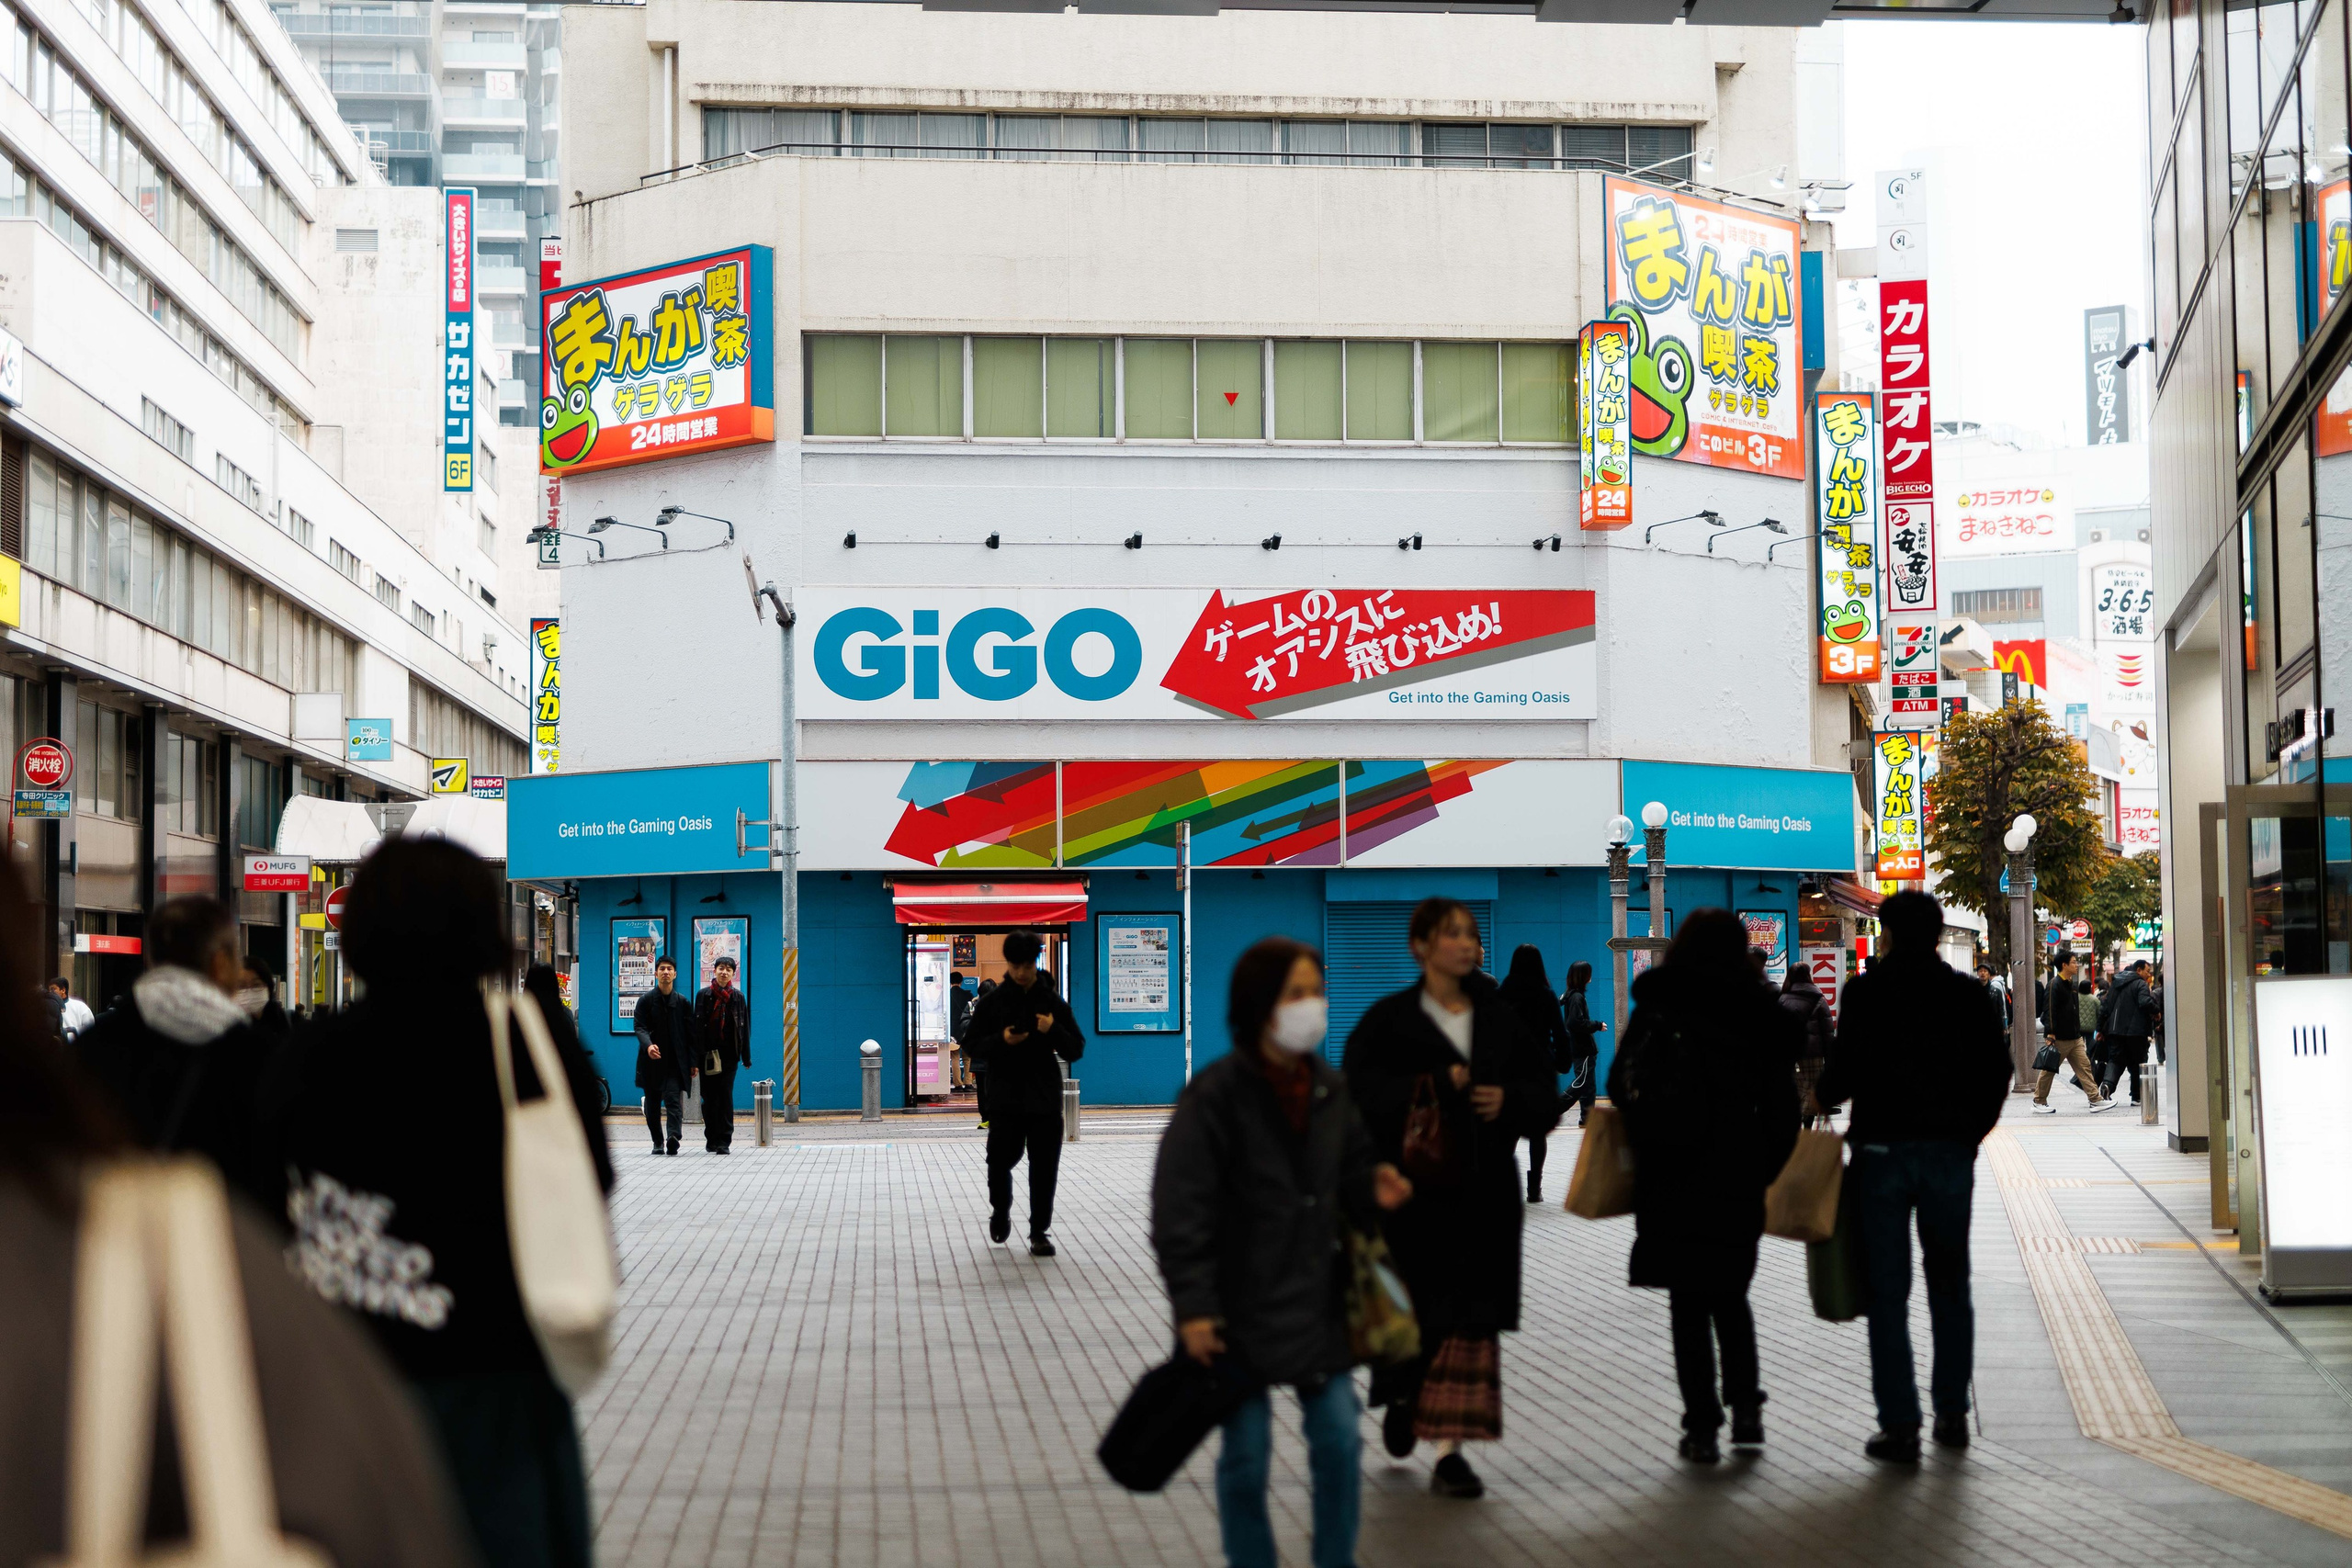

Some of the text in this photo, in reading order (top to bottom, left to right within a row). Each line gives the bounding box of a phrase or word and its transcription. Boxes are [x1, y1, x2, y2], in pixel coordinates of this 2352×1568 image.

[1910, 171, 1922, 180] 5F
[452, 203, 467, 302] 大きいサイズの店
[1619, 199, 1792, 328] まんが
[2091, 342, 2117, 354] LAB
[447, 321, 470, 445] サカゼン
[1883, 299, 1930, 474] カラオケ
[613, 371, 714, 421] ゲラゲラ
[1709, 389, 1770, 419] ゲラゲラ
[1701, 412, 1722, 423] COMIC
[1728, 417, 1759, 429] INTERNET
[630, 416, 718, 451] 24時間営業
[449, 460, 469, 479] 6F
[1886, 483, 1932, 495] BIG ECHO
[1972, 489, 2040, 506] カラオケ
[1597, 490, 1626, 507] 24
[1892, 510, 1910, 524] 2F
[1959, 514, 2053, 542] まねきねこ
[1204, 589, 1337, 663] ゲームの
[2112, 615, 2143, 636] 酒場
[1244, 589, 1407, 694] オアシスに
[813, 606, 1143, 702] GiGO
[1829, 645, 1873, 675] 3F
[1898, 673, 1930, 685] たばこ
[1388, 691, 1570, 706] Get into the Gaming Oasis
[1907, 686, 1921, 698] 酒
[1902, 700, 1929, 711] ATM
[362, 737, 388, 745] ダイソー
[28, 757, 62, 773] 消火栓
[472, 778, 503, 787] 大きいサイズ
[22, 792, 65, 800] 寺田クリニック
[472, 789, 503, 798] サカゼン
[1670, 810, 1812, 833] Get into the Gaming Oasis
[2120, 807, 2153, 819] ラオケ
[559, 814, 713, 839] Get into the Gaming Oasis
[269, 862, 297, 870] MUFG
[1895, 856, 1920, 870] 入口
[253, 878, 300, 886] 三菱UFJ銀行
[1745, 916, 1776, 931] レシート
